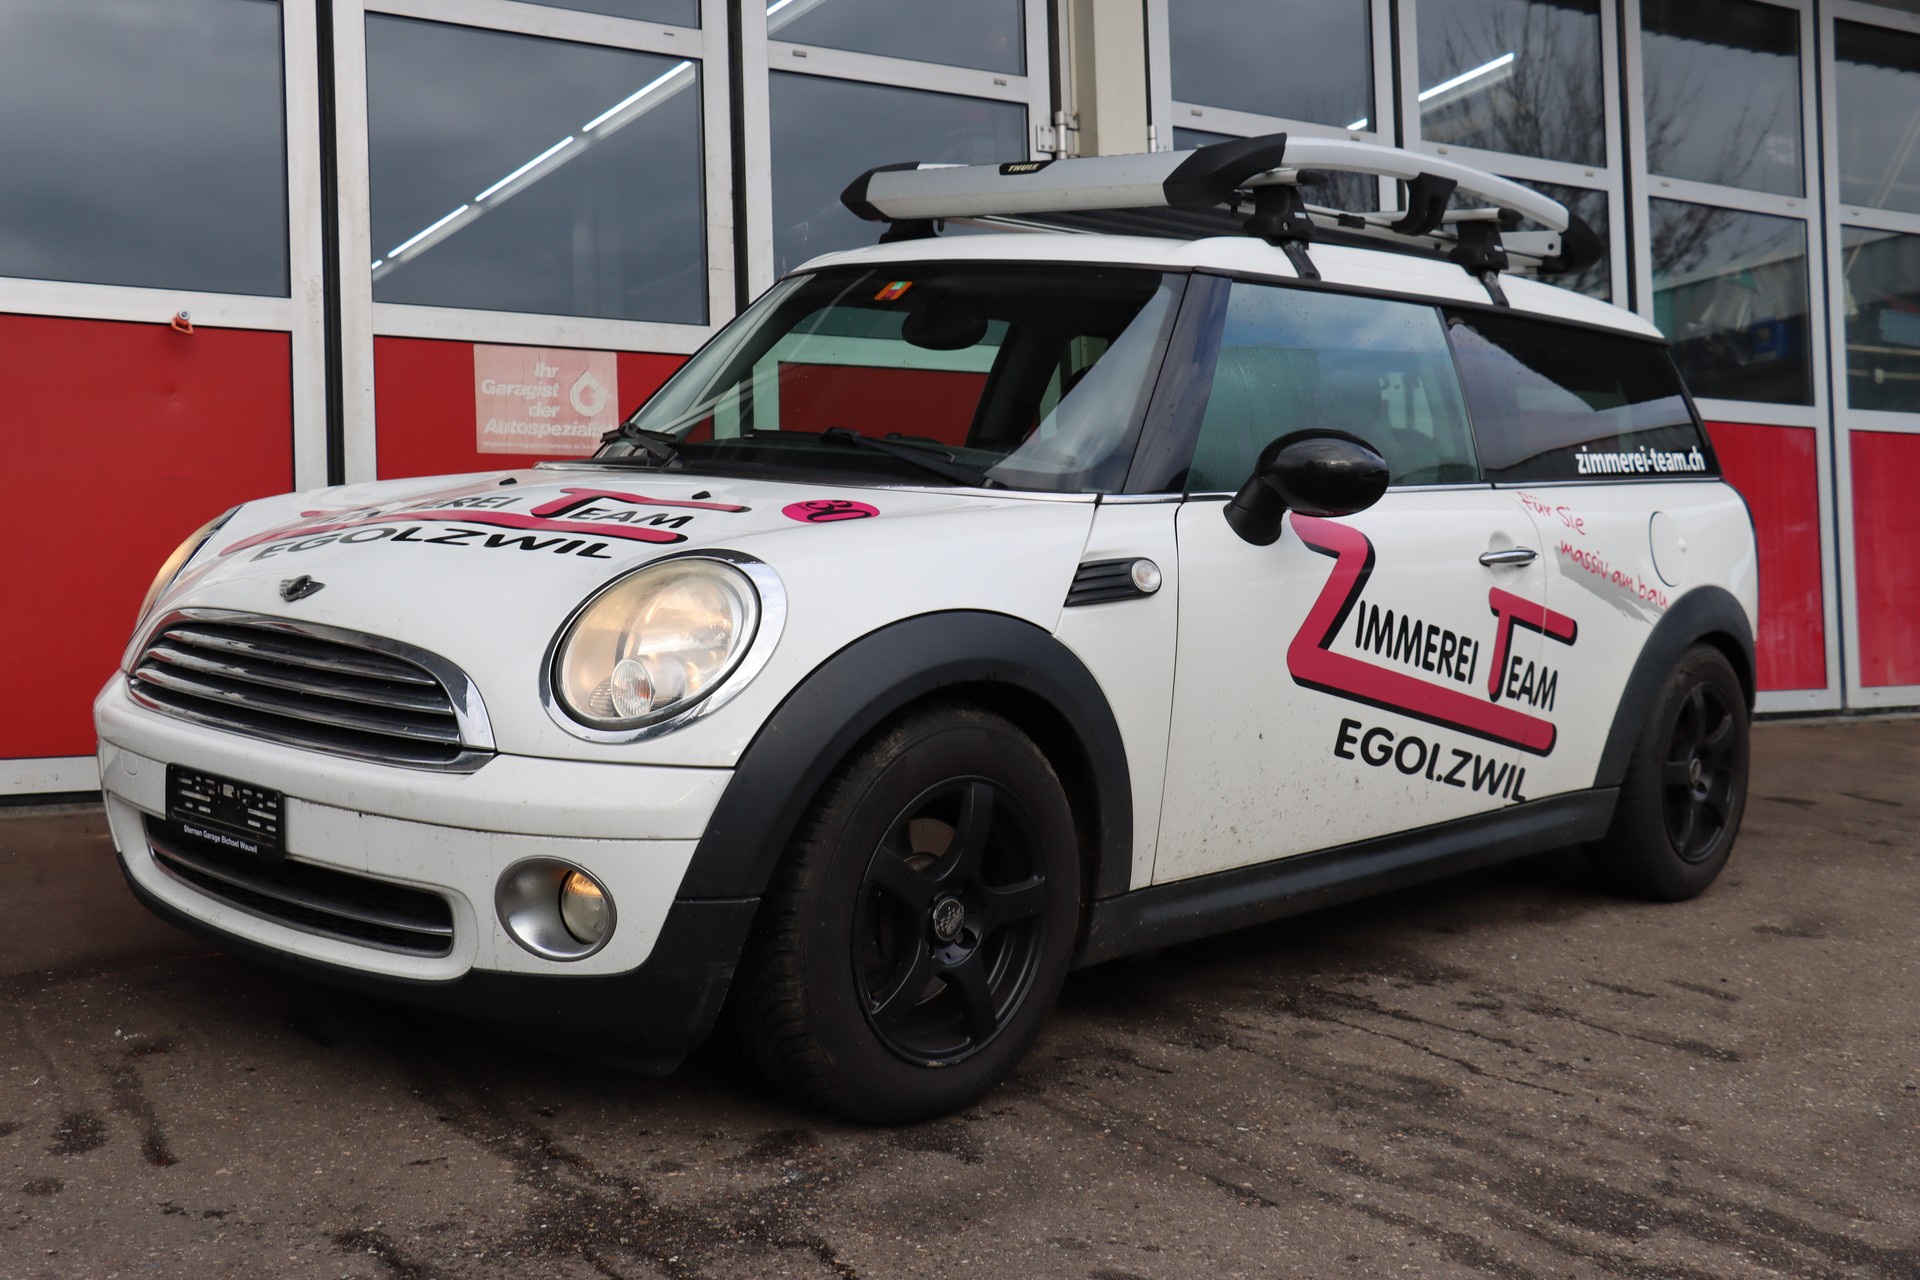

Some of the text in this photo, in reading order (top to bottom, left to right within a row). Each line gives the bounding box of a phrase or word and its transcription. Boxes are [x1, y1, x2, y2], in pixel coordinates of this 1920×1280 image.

[534, 362, 559, 378] Ihr
[481, 378, 559, 400] Garagist
[528, 401, 560, 417] der
[1575, 445, 1706, 474] zimmerei-team.ch
[530, 487, 752, 528] TEAM
[1556, 506, 1586, 535] Sie
[249, 526, 612, 562] EGOLZWIL
[1560, 540, 1669, 610] massiv am bau
[1488, 586, 1578, 712] TEAM
[184, 824, 258, 853] Sternen Garage Bichsel Wauwil
